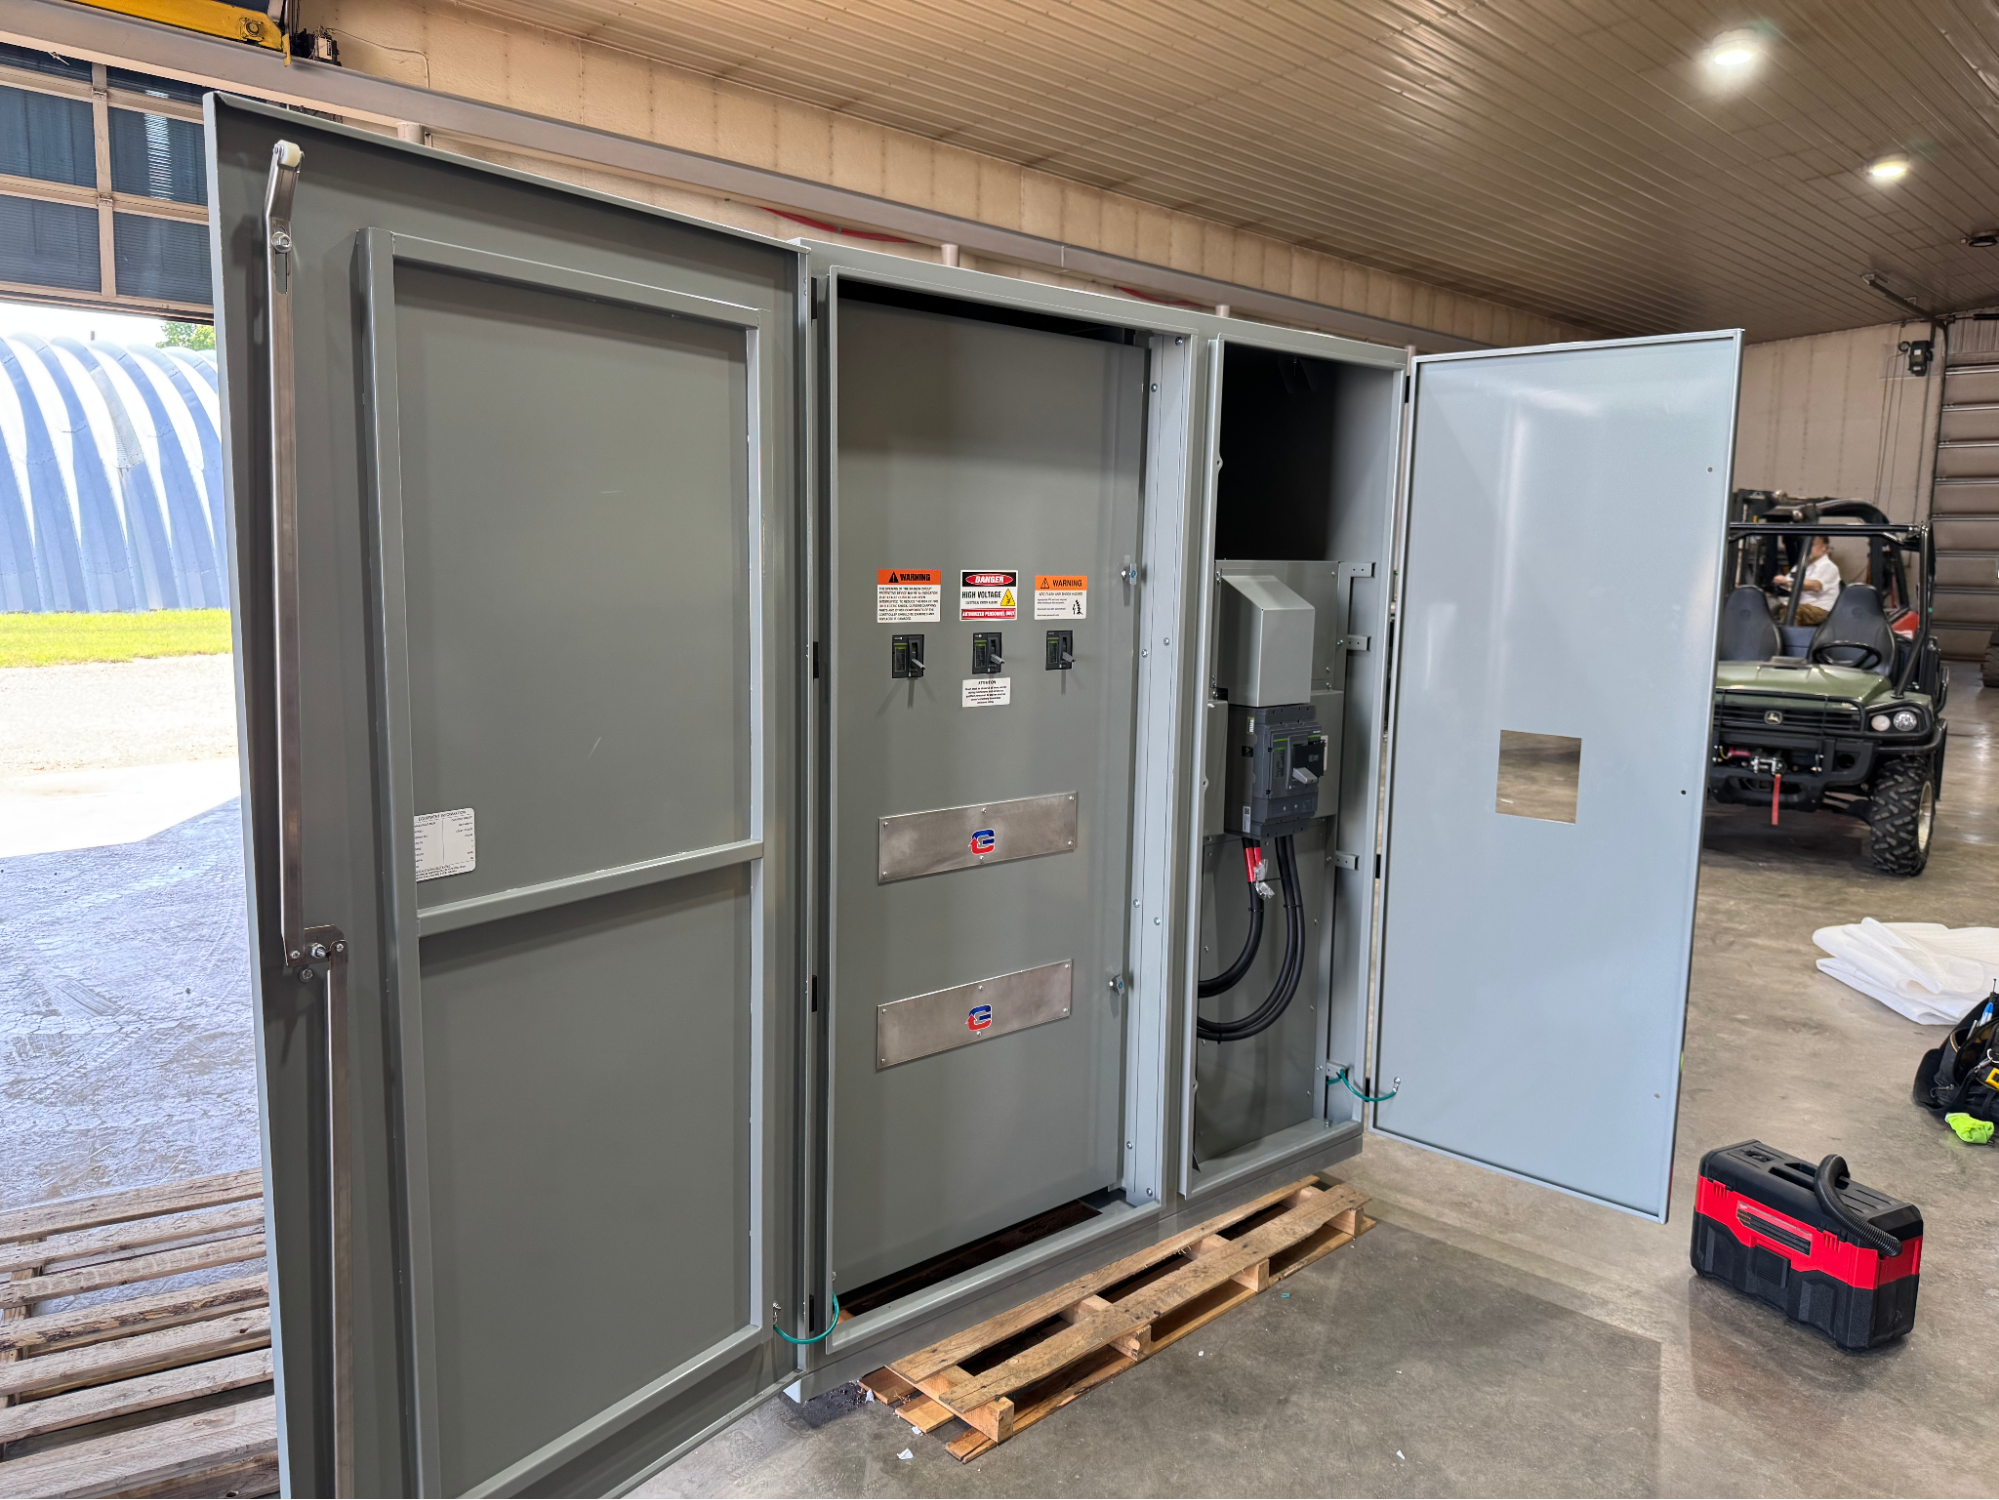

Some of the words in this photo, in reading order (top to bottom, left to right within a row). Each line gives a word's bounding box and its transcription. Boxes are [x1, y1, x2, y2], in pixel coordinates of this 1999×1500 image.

[975, 576, 1004, 584] DANGER
[962, 591, 976, 599] HIGH
[978, 591, 1001, 599] VOLTAGE
